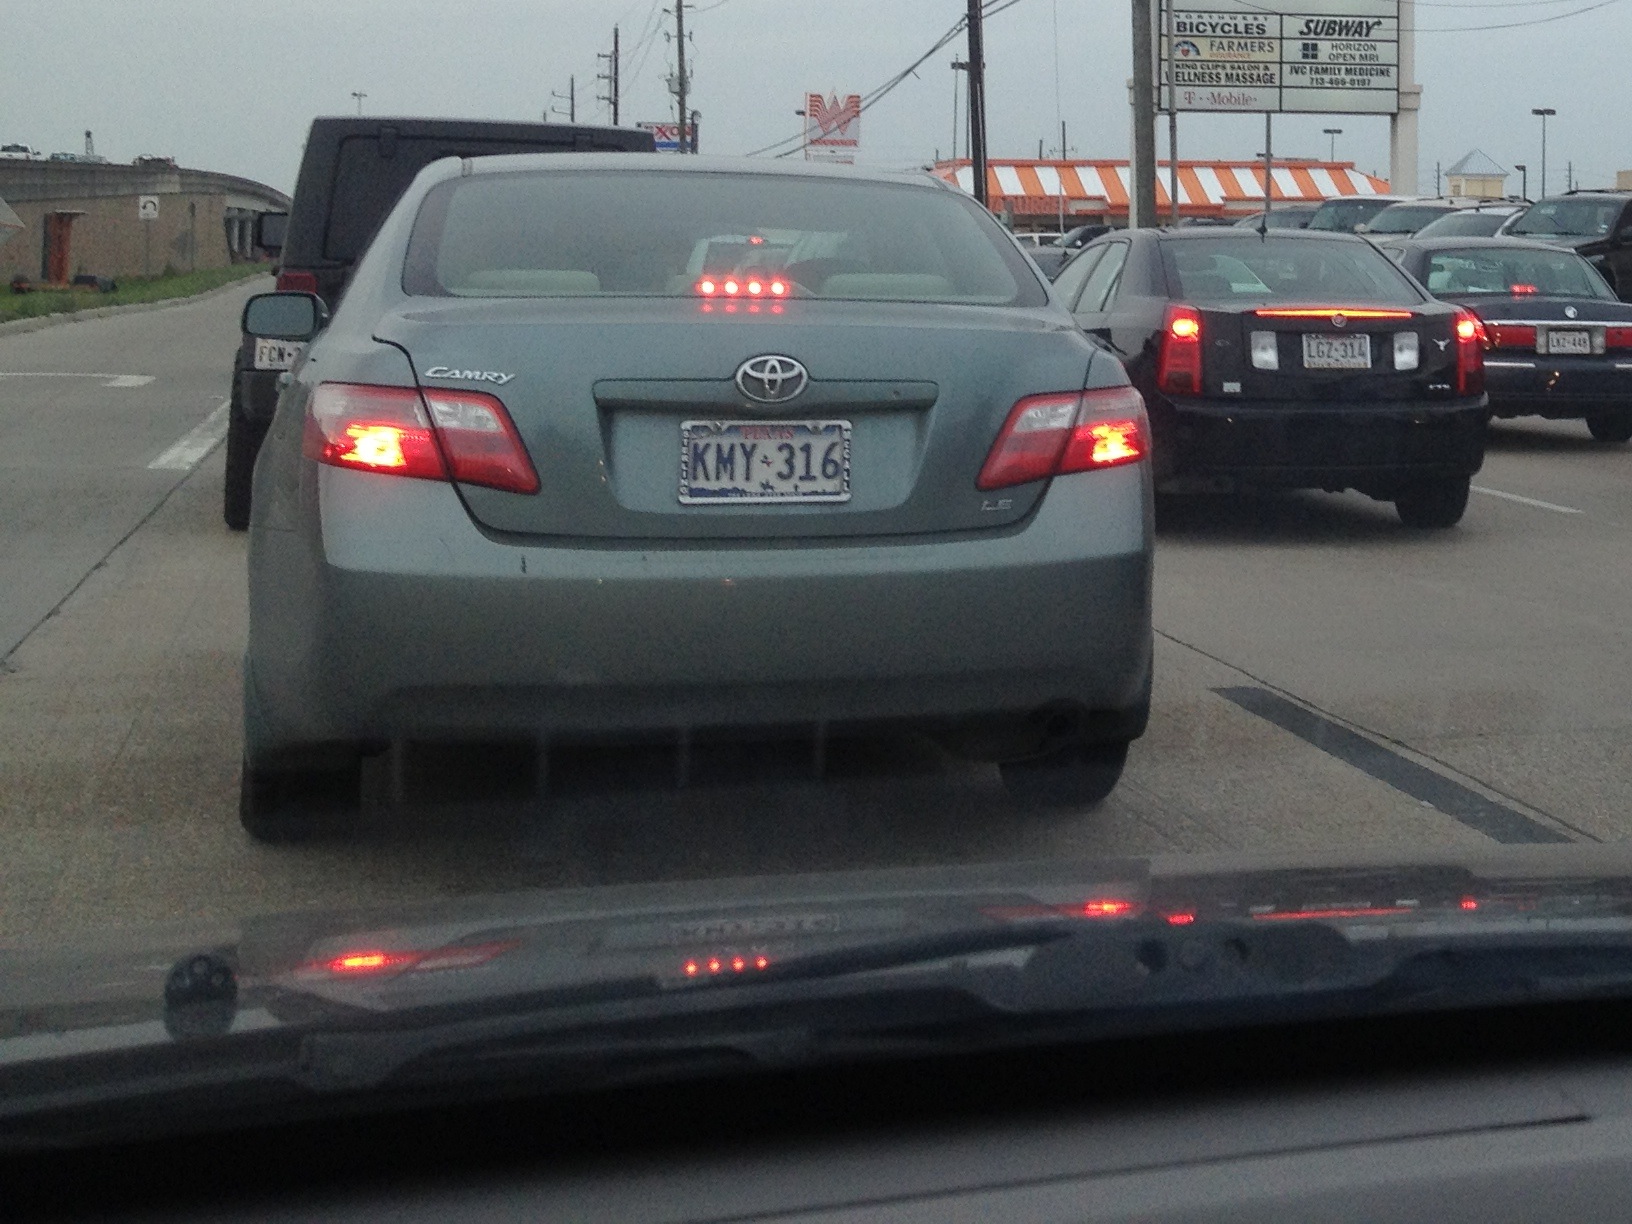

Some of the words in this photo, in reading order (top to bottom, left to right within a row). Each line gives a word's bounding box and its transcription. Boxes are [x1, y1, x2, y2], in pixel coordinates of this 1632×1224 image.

[1176, 21, 1267, 36] BICYCLES
[1299, 18, 1383, 38] SUBWAY
[1209, 39, 1276, 54] FARMERS
[1331, 42, 1378, 52] HORIZON
[1328, 53, 1357, 62] OPEN
[1359, 53, 1380, 63] MRI
[1175, 62, 1198, 71] KING
[1230, 63, 1261, 72] SALON
[1309, 65, 1343, 77] FAMILY
[1344, 66, 1392, 78] MEDICINE
[1224, 71, 1277, 85] MASSAGE
